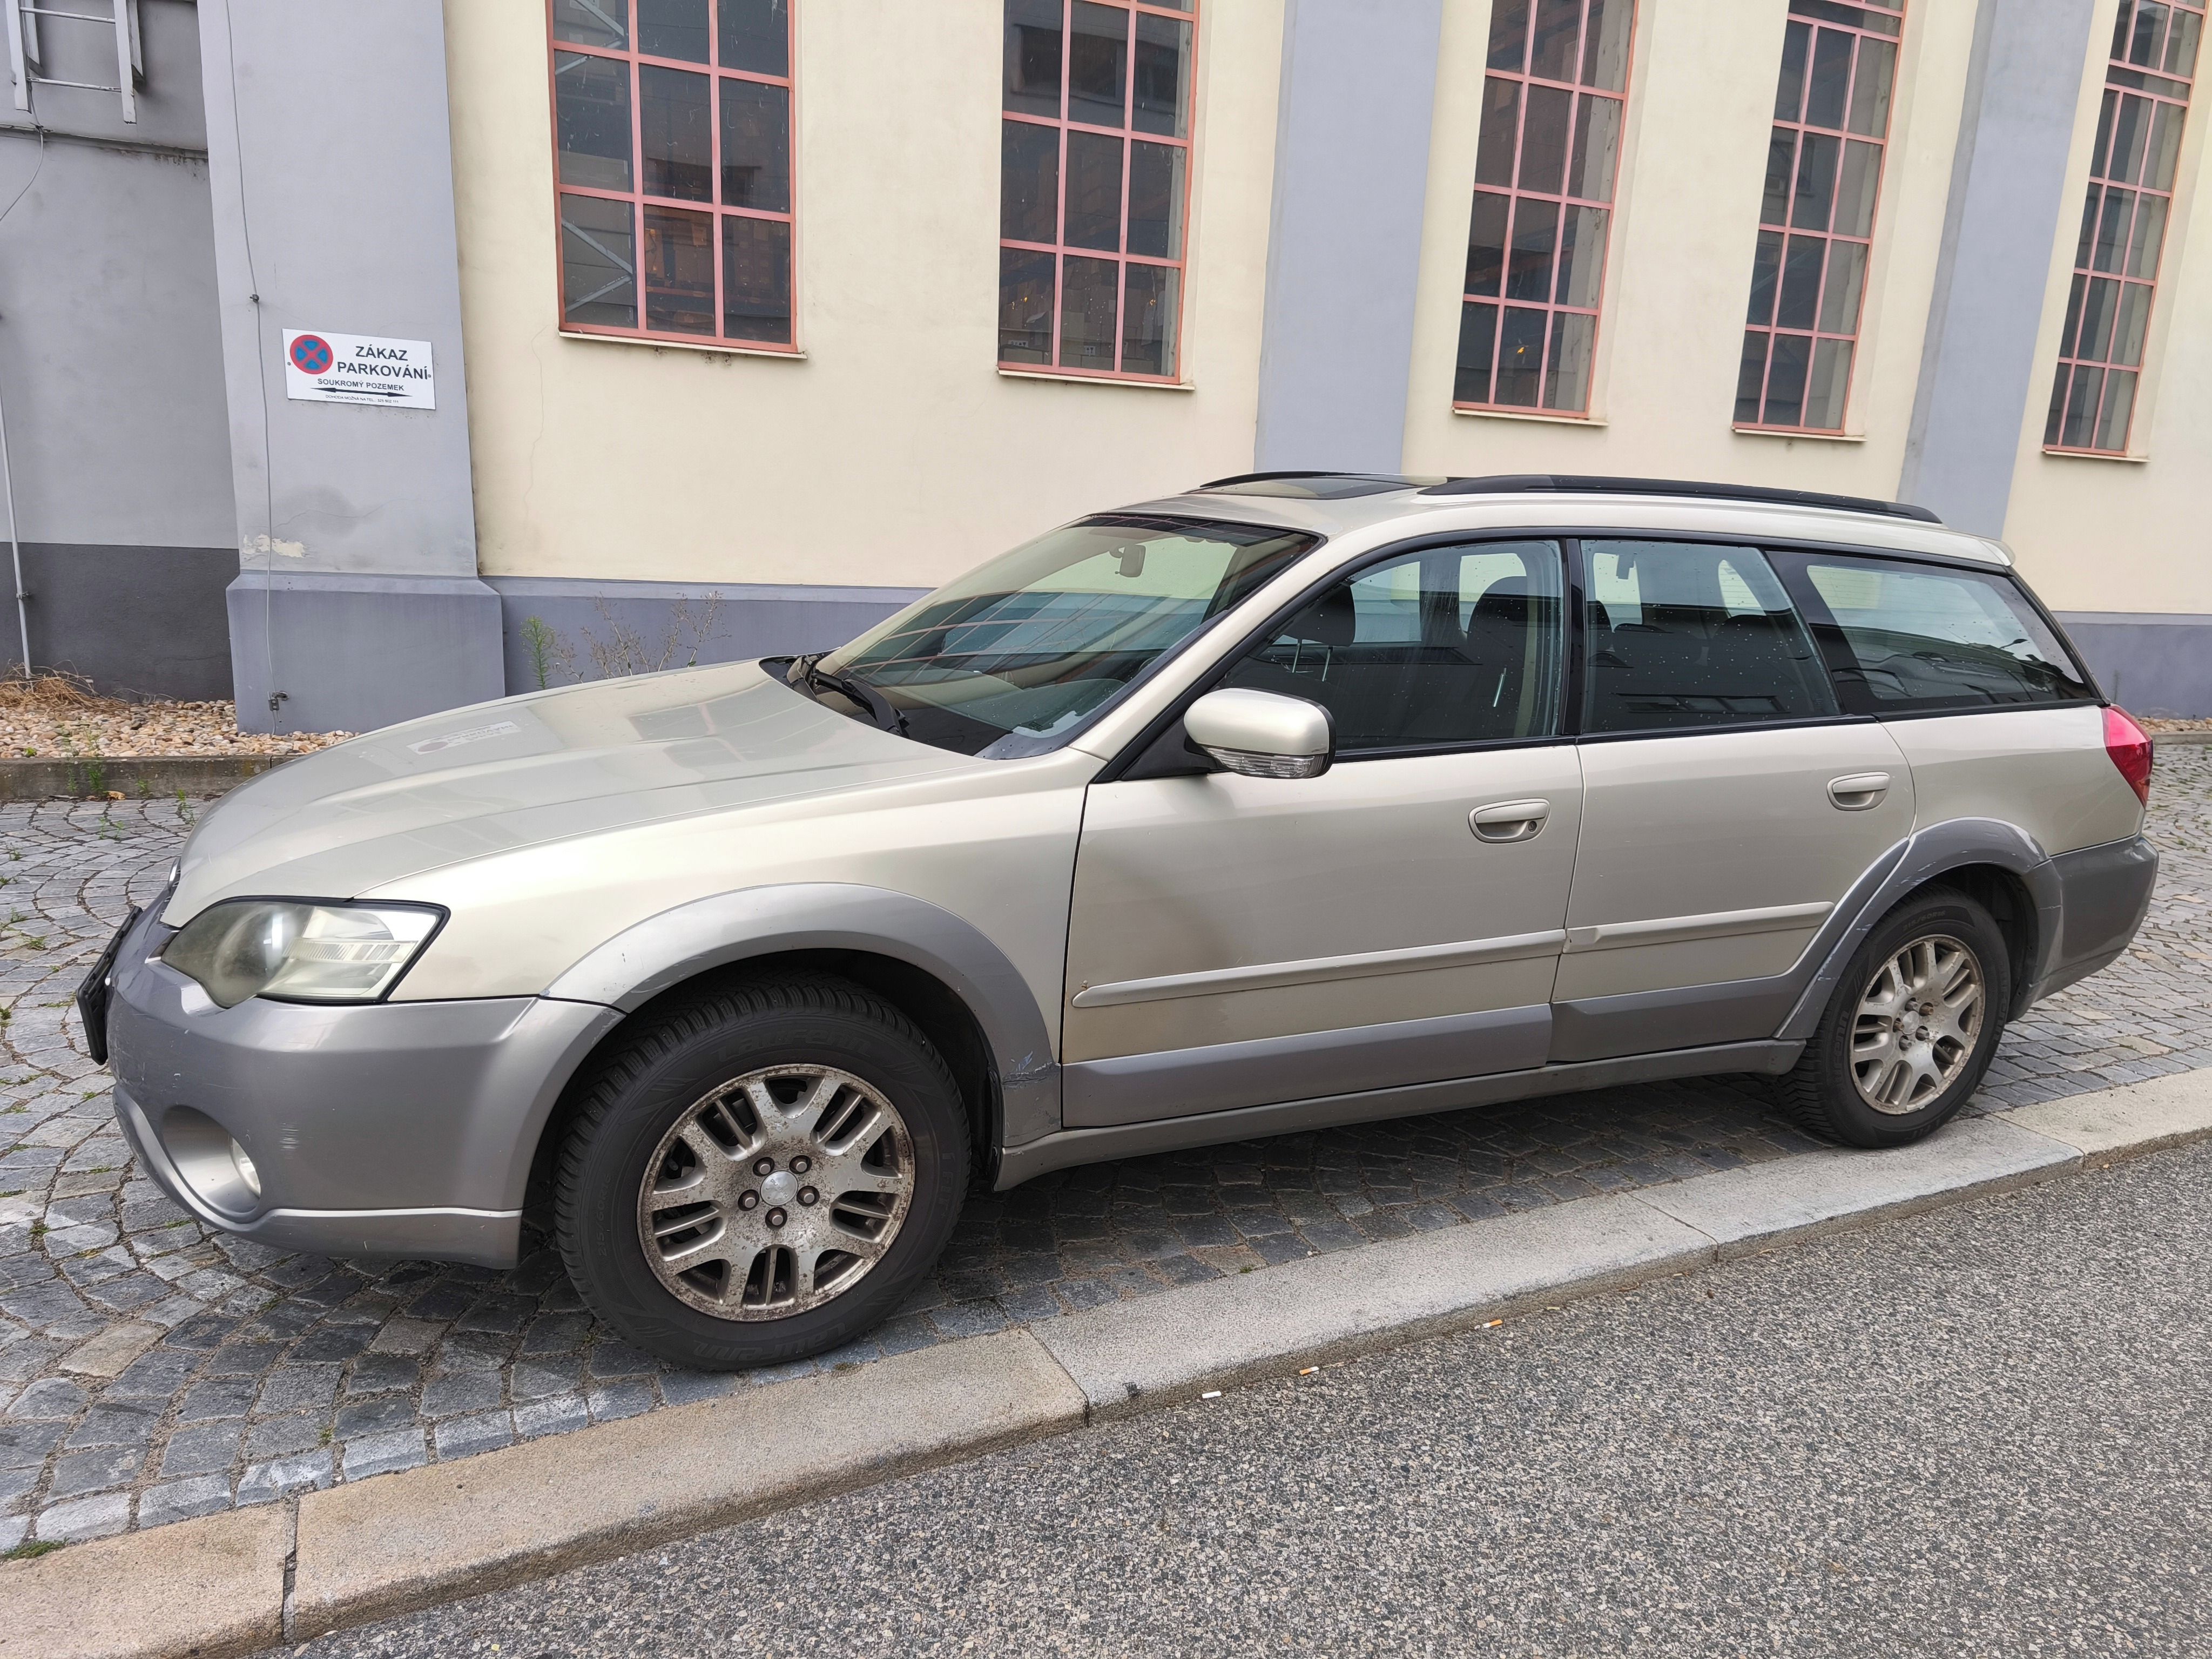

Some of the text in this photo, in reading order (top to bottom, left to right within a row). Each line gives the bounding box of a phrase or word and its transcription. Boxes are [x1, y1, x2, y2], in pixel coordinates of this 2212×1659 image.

[355, 344, 408, 361] ZÁKAZ
[337, 361, 428, 380] PARKOVÁNÍ
[317, 378, 405, 391] SOUKROMÝ POZEMEK
